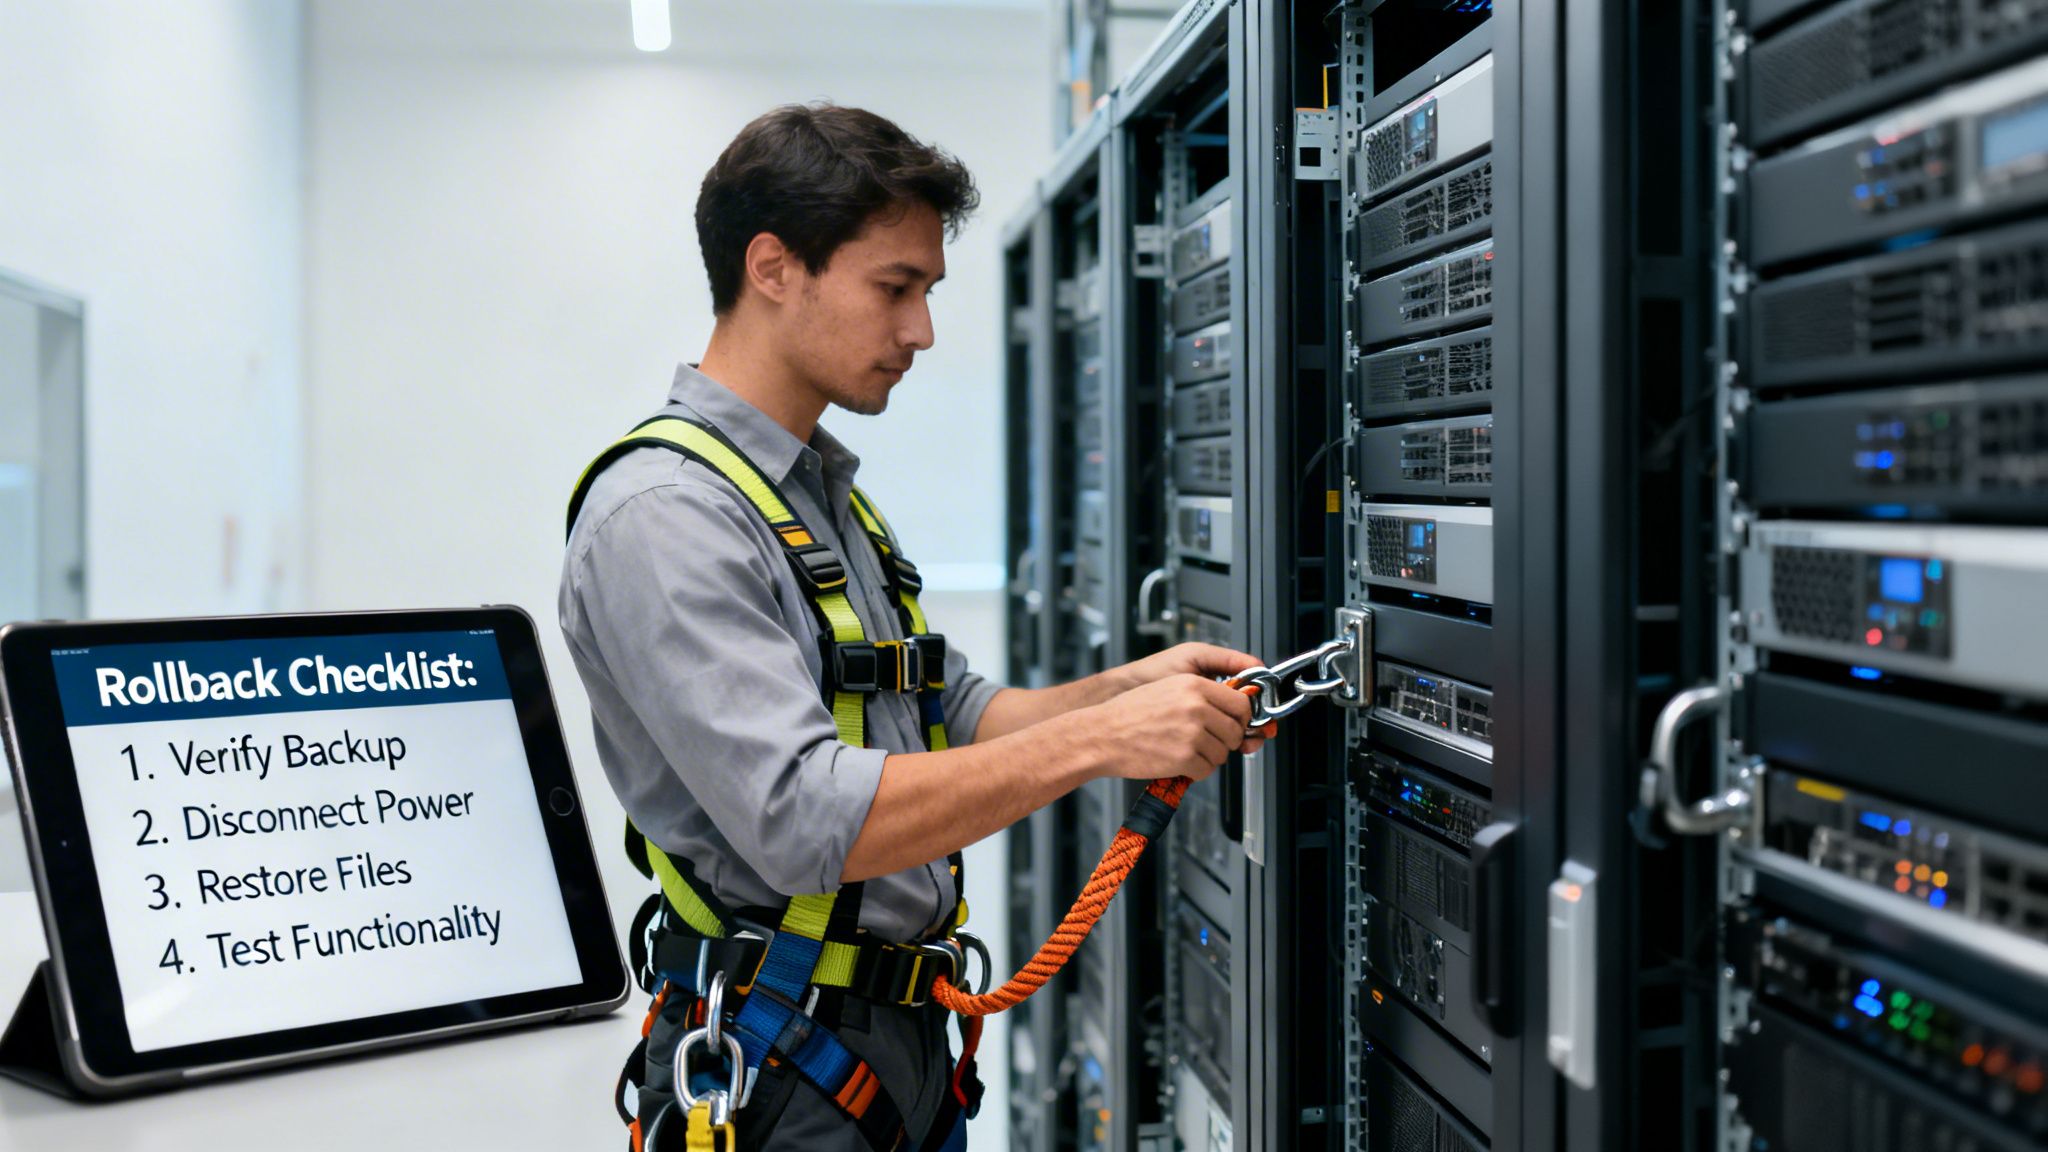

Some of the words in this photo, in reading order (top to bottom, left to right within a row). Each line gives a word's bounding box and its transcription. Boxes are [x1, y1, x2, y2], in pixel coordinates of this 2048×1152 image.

[95, 657, 282, 707] Rollback
[288, 651, 477, 696] Checklist:
[120, 744, 155, 781] 1.
[167, 733, 272, 781] Verify
[282, 729, 407, 771] Backup
[132, 809, 169, 847] 2.
[182, 794, 369, 841] Disconnect
[374, 789, 474, 824] Power
[144, 873, 181, 911] 3.
[196, 865, 329, 905] Restore
[335, 851, 412, 891] Files
[158, 938, 196, 975] 4.
[205, 930, 285, 969] Test
[291, 904, 501, 960] Functionality
